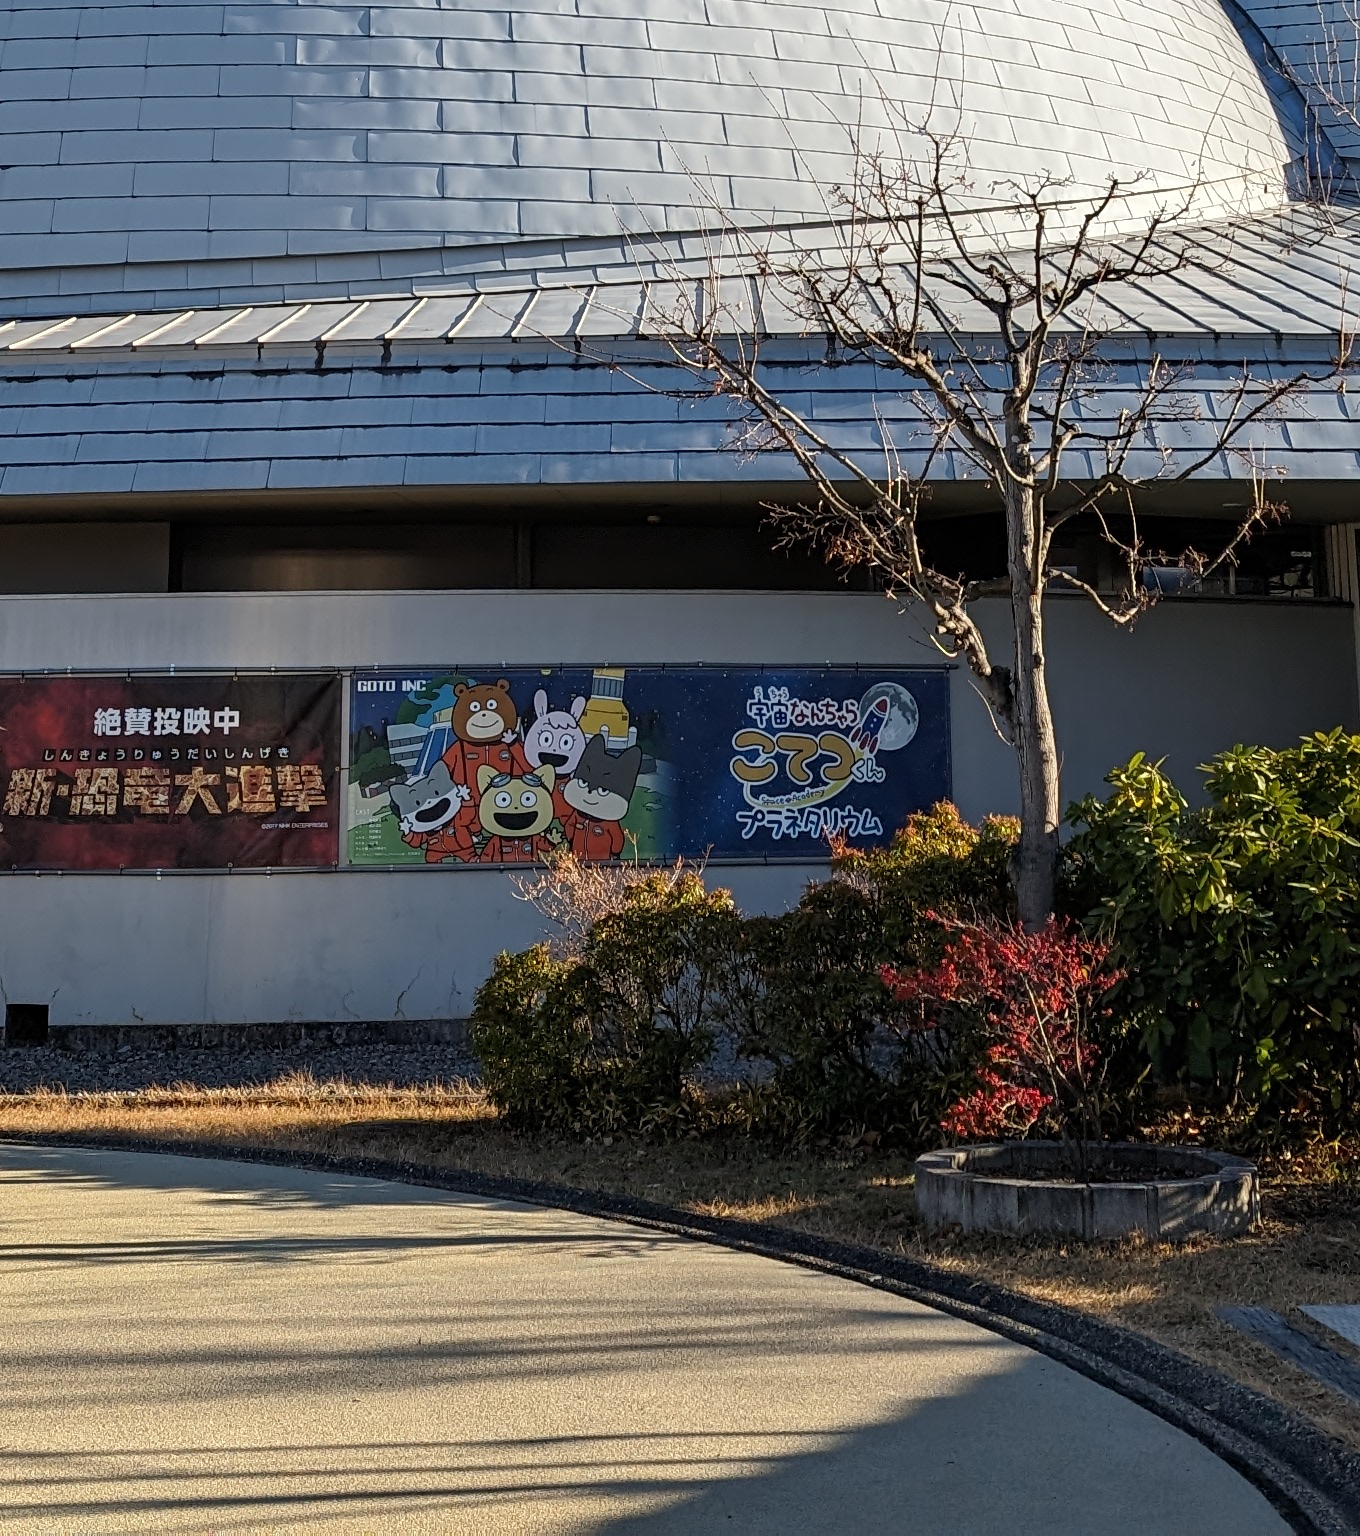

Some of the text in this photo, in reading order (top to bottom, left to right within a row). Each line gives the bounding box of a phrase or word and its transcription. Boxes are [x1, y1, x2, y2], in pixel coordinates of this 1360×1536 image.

[357, 680, 396, 692] GOTO
[94, 706, 240, 737] 絶賛投映中
[747, 698, 859, 727] 宇宙なんちゃら
[42, 746, 290, 762] しんきょうりゅうだいしんげき
[736, 805, 883, 840] プラネタリウム
